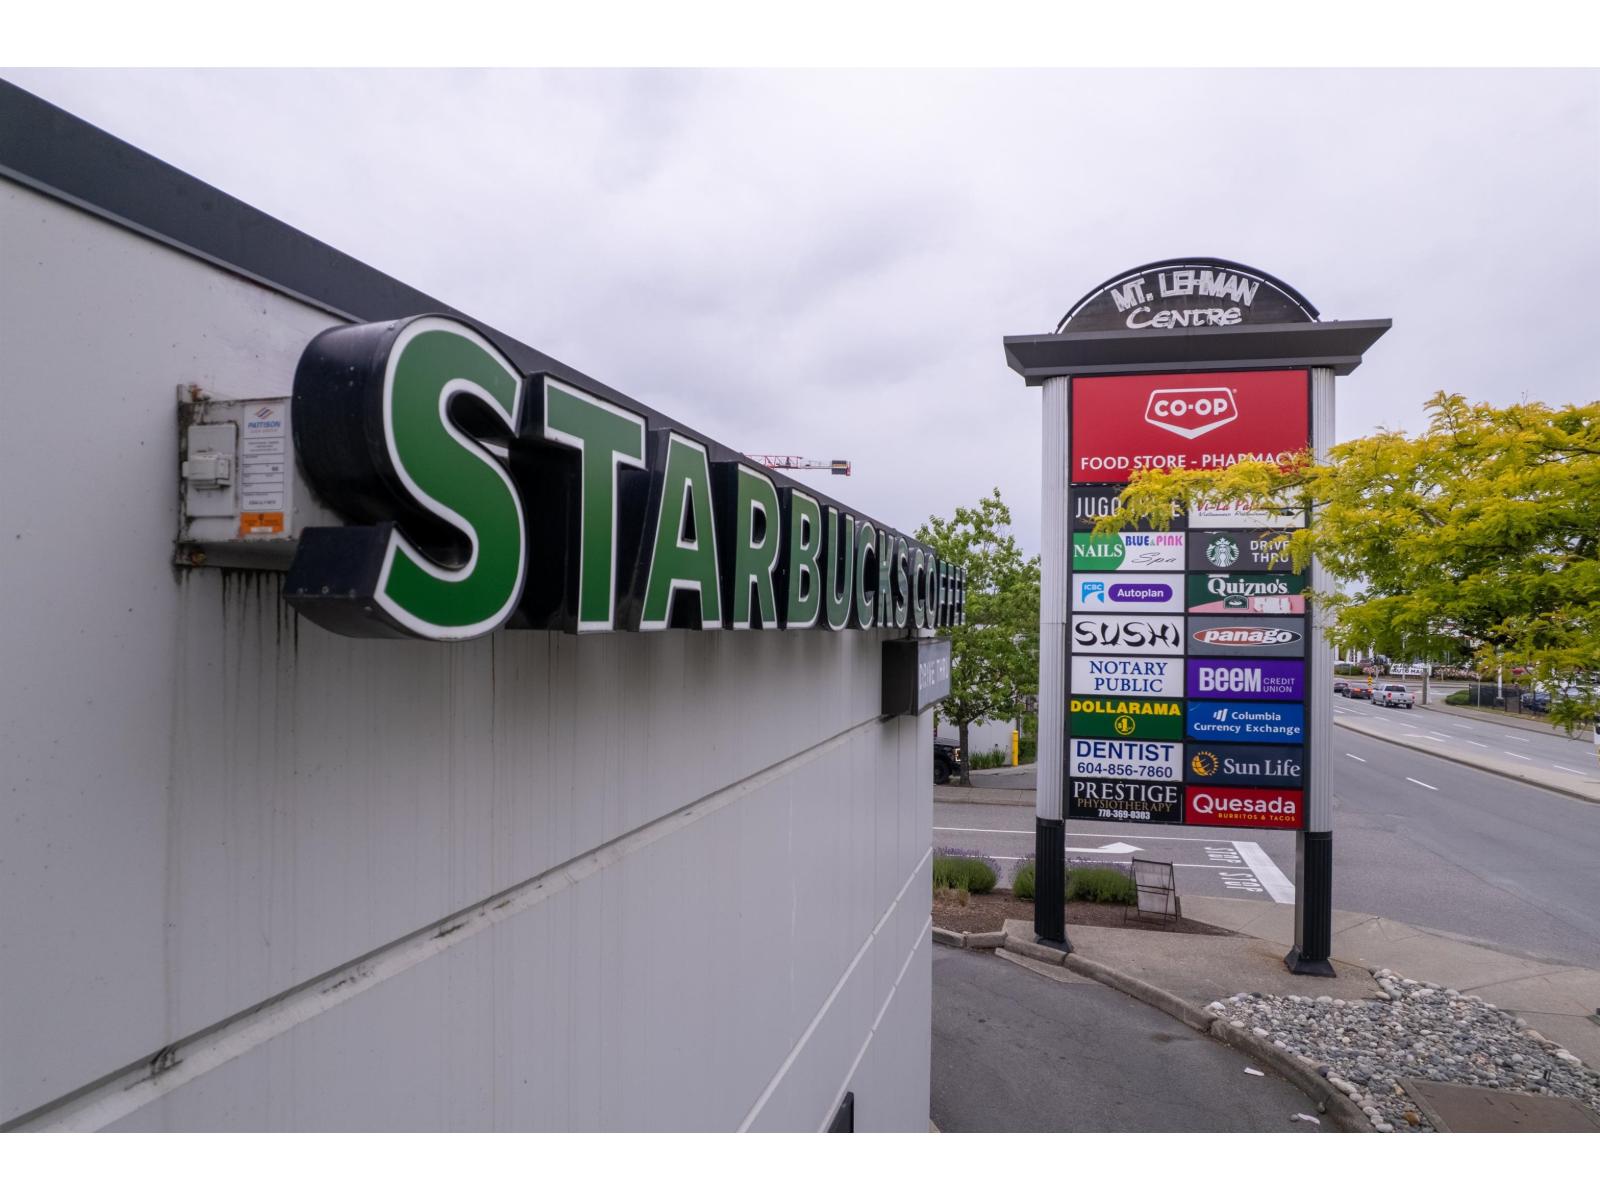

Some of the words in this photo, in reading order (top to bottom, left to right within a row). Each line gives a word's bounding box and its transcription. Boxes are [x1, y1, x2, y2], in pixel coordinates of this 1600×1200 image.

[1110, 277, 1154, 313] MT.
[1158, 269, 1260, 307] LEHMAN
[1081, 456, 1129, 470] FOOD
[1133, 454, 1187, 469] STORE
[374, 312, 908, 642] STARBUCKS
[1075, 496, 1122, 518] JUGO
[1125, 535, 1150, 547] BLUE
[1156, 535, 1183, 547] PINK
[1074, 544, 1123, 558] NAILS
[1130, 552, 1177, 566] Spa
[1117, 588, 1164, 599] Autoplan
[1207, 574, 1288, 597] Quizno's
[1074, 621, 1181, 648] SUSHI
[1203, 628, 1293, 644] panago
[1089, 660, 1168, 676] NOTARY
[1094, 677, 1163, 693] PUBLIC
[1263, 677, 1295, 686] CREDIT
[1263, 685, 1292, 693] UNION
[1070, 700, 1181, 716] DOLLARAMA
[1231, 711, 1281, 721] Columbia
[1193, 722, 1241, 734] Currency
[1245, 723, 1301, 736] Exchange
[1076, 740, 1174, 762] DENTIST
[1077, 762, 1173, 778] 604-856-7860
[1223, 758, 1261, 775] Sun
[1264, 759, 1301, 777] Life
[1073, 781, 1178, 803] PRESTIGE
[1077, 798, 1173, 812] PHYSIOTHERAPY
[1193, 793, 1296, 814] Quesada
[1218, 812, 1258, 820] BURRITOS
